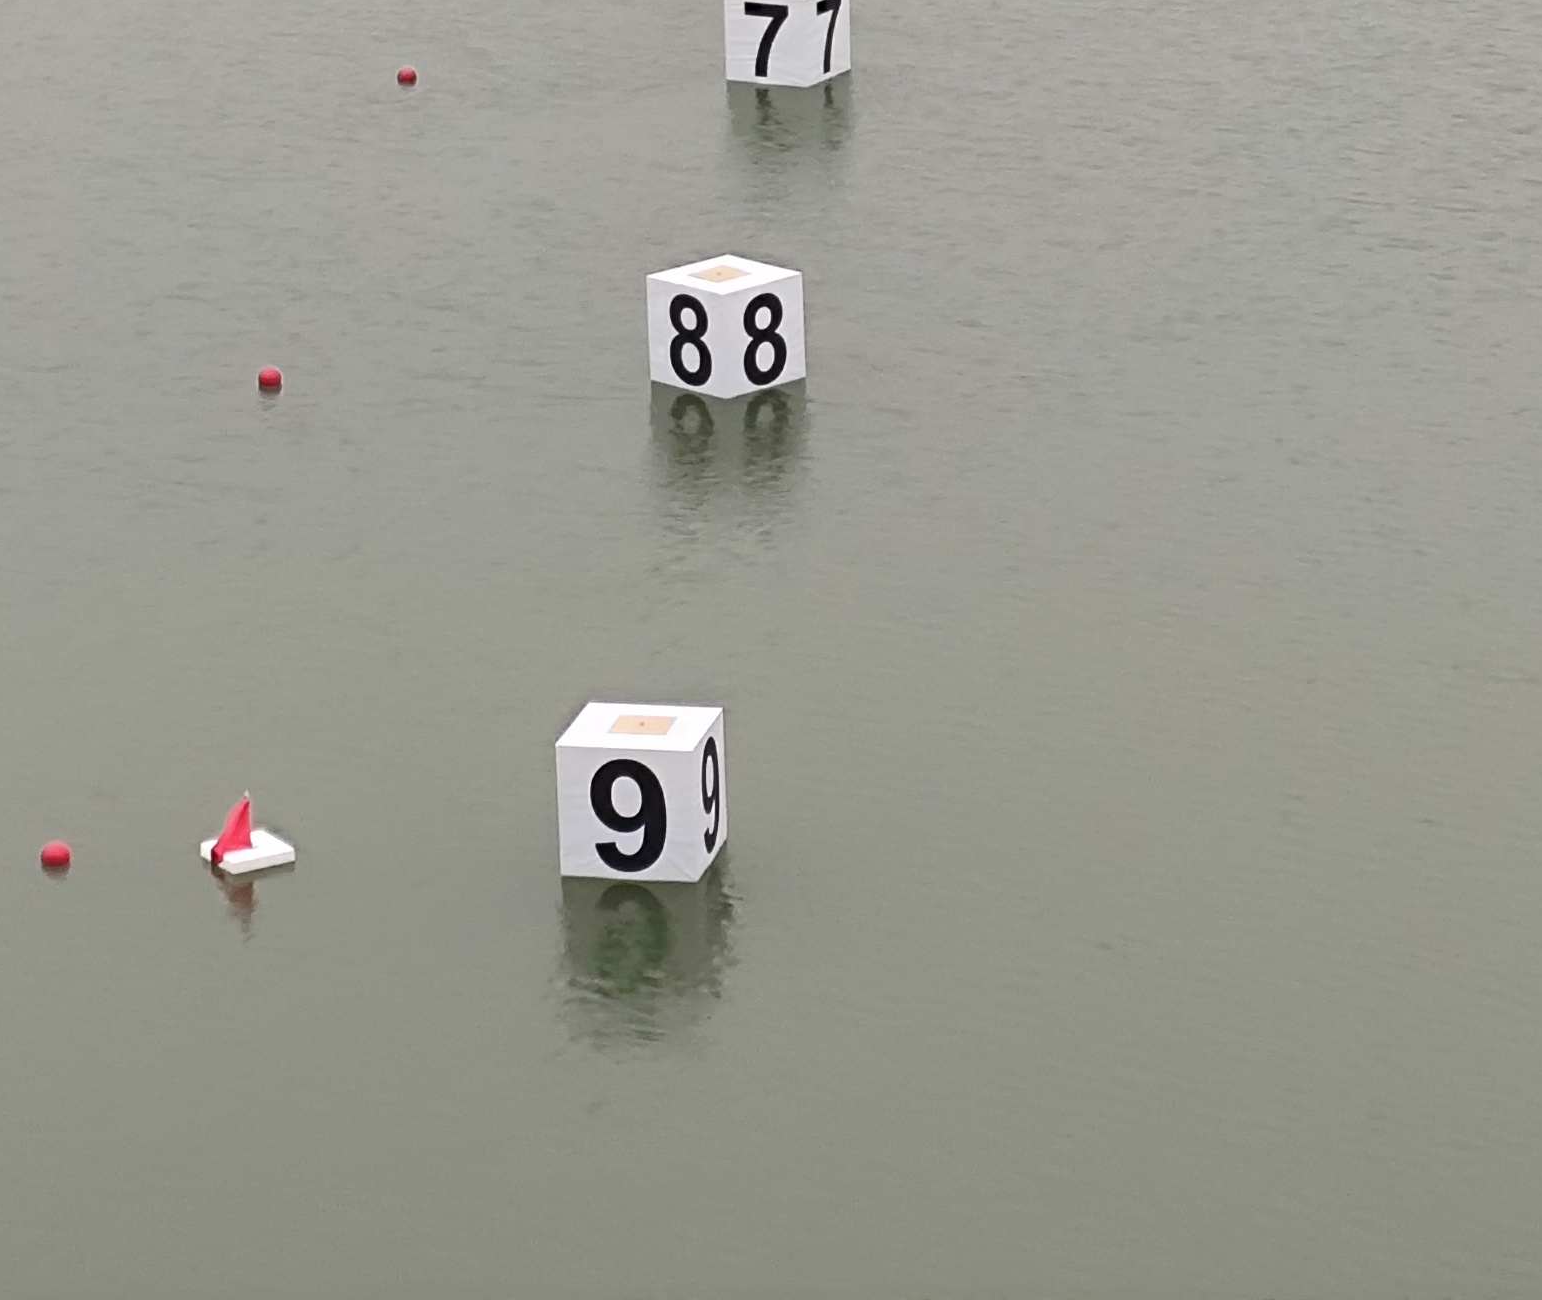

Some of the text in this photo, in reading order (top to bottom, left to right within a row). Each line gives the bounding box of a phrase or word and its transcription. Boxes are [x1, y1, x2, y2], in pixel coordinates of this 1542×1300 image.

[743, 1, 789, 78] 7
[669, 292, 788, 387] 8 8
[589, 736, 720, 873] 9 9
